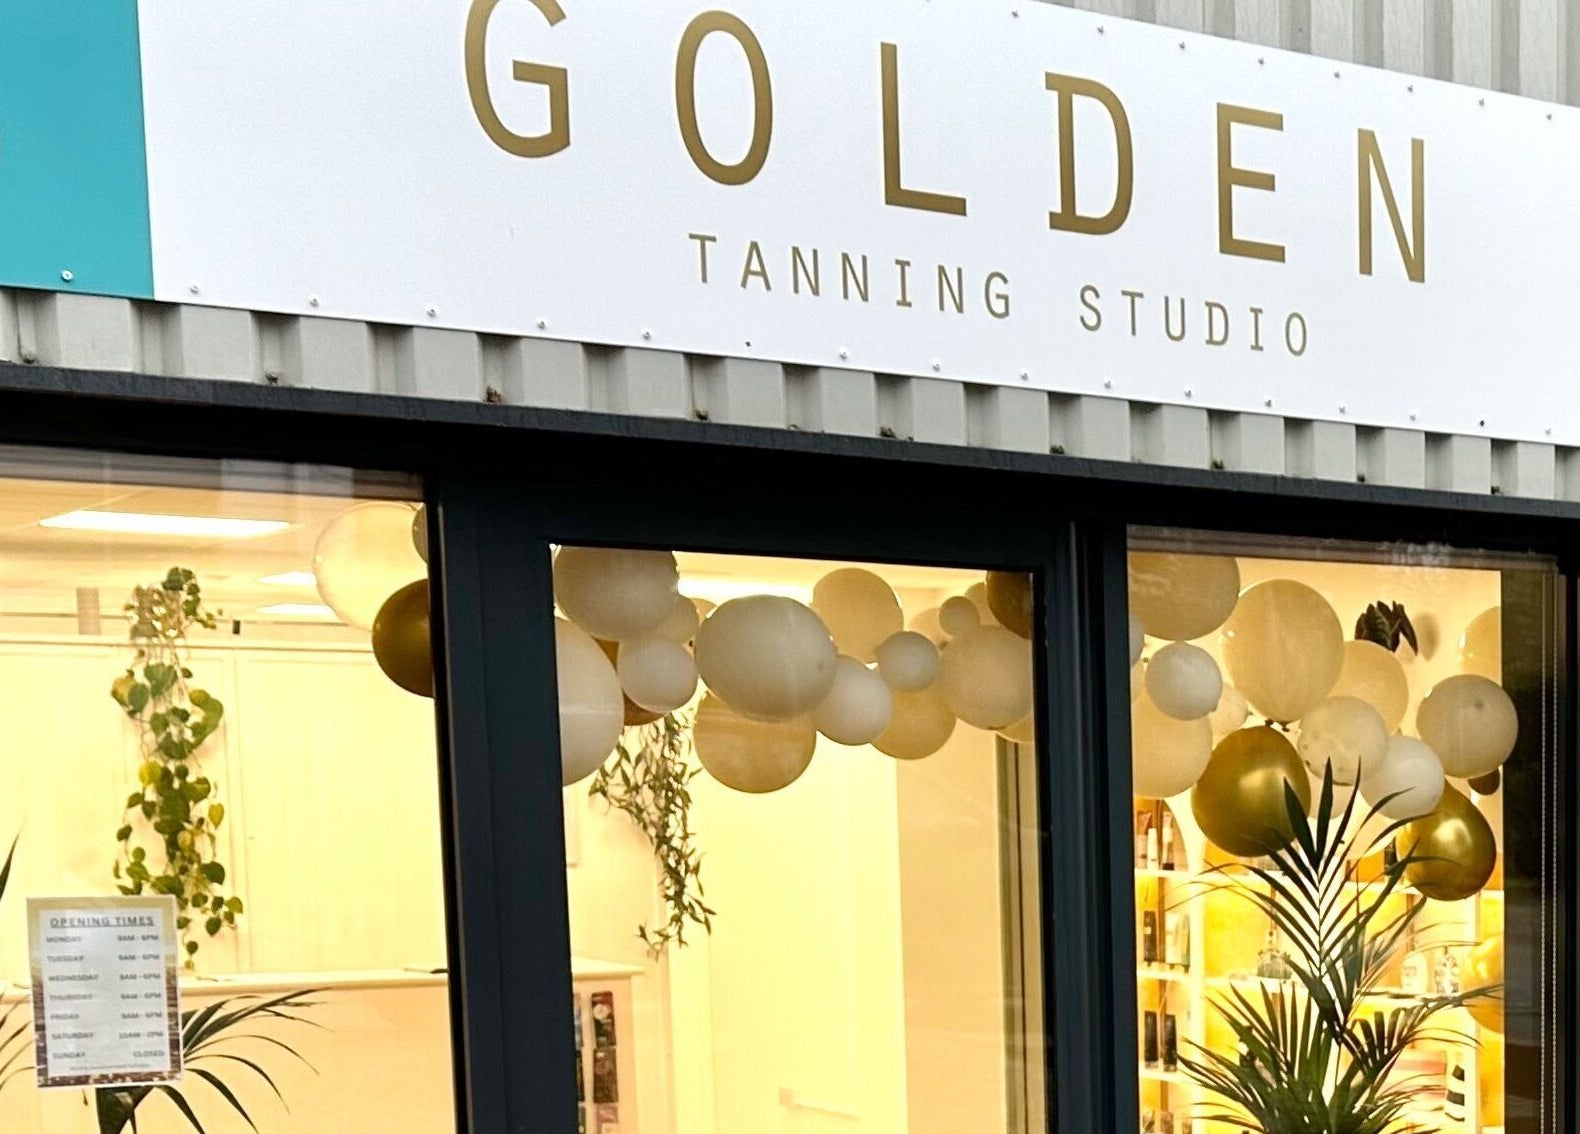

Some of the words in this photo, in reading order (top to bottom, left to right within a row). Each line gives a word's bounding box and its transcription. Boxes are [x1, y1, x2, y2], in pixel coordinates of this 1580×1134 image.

[463, 0, 1427, 284] GOLDEN
[688, 232, 1012, 320] TANNING
[1079, 284, 1310, 357] STUDIO
[50, 917, 111, 929] OPENING
[115, 915, 155, 927] TIMES
[53, 1052, 86, 1060] SUNDAY
